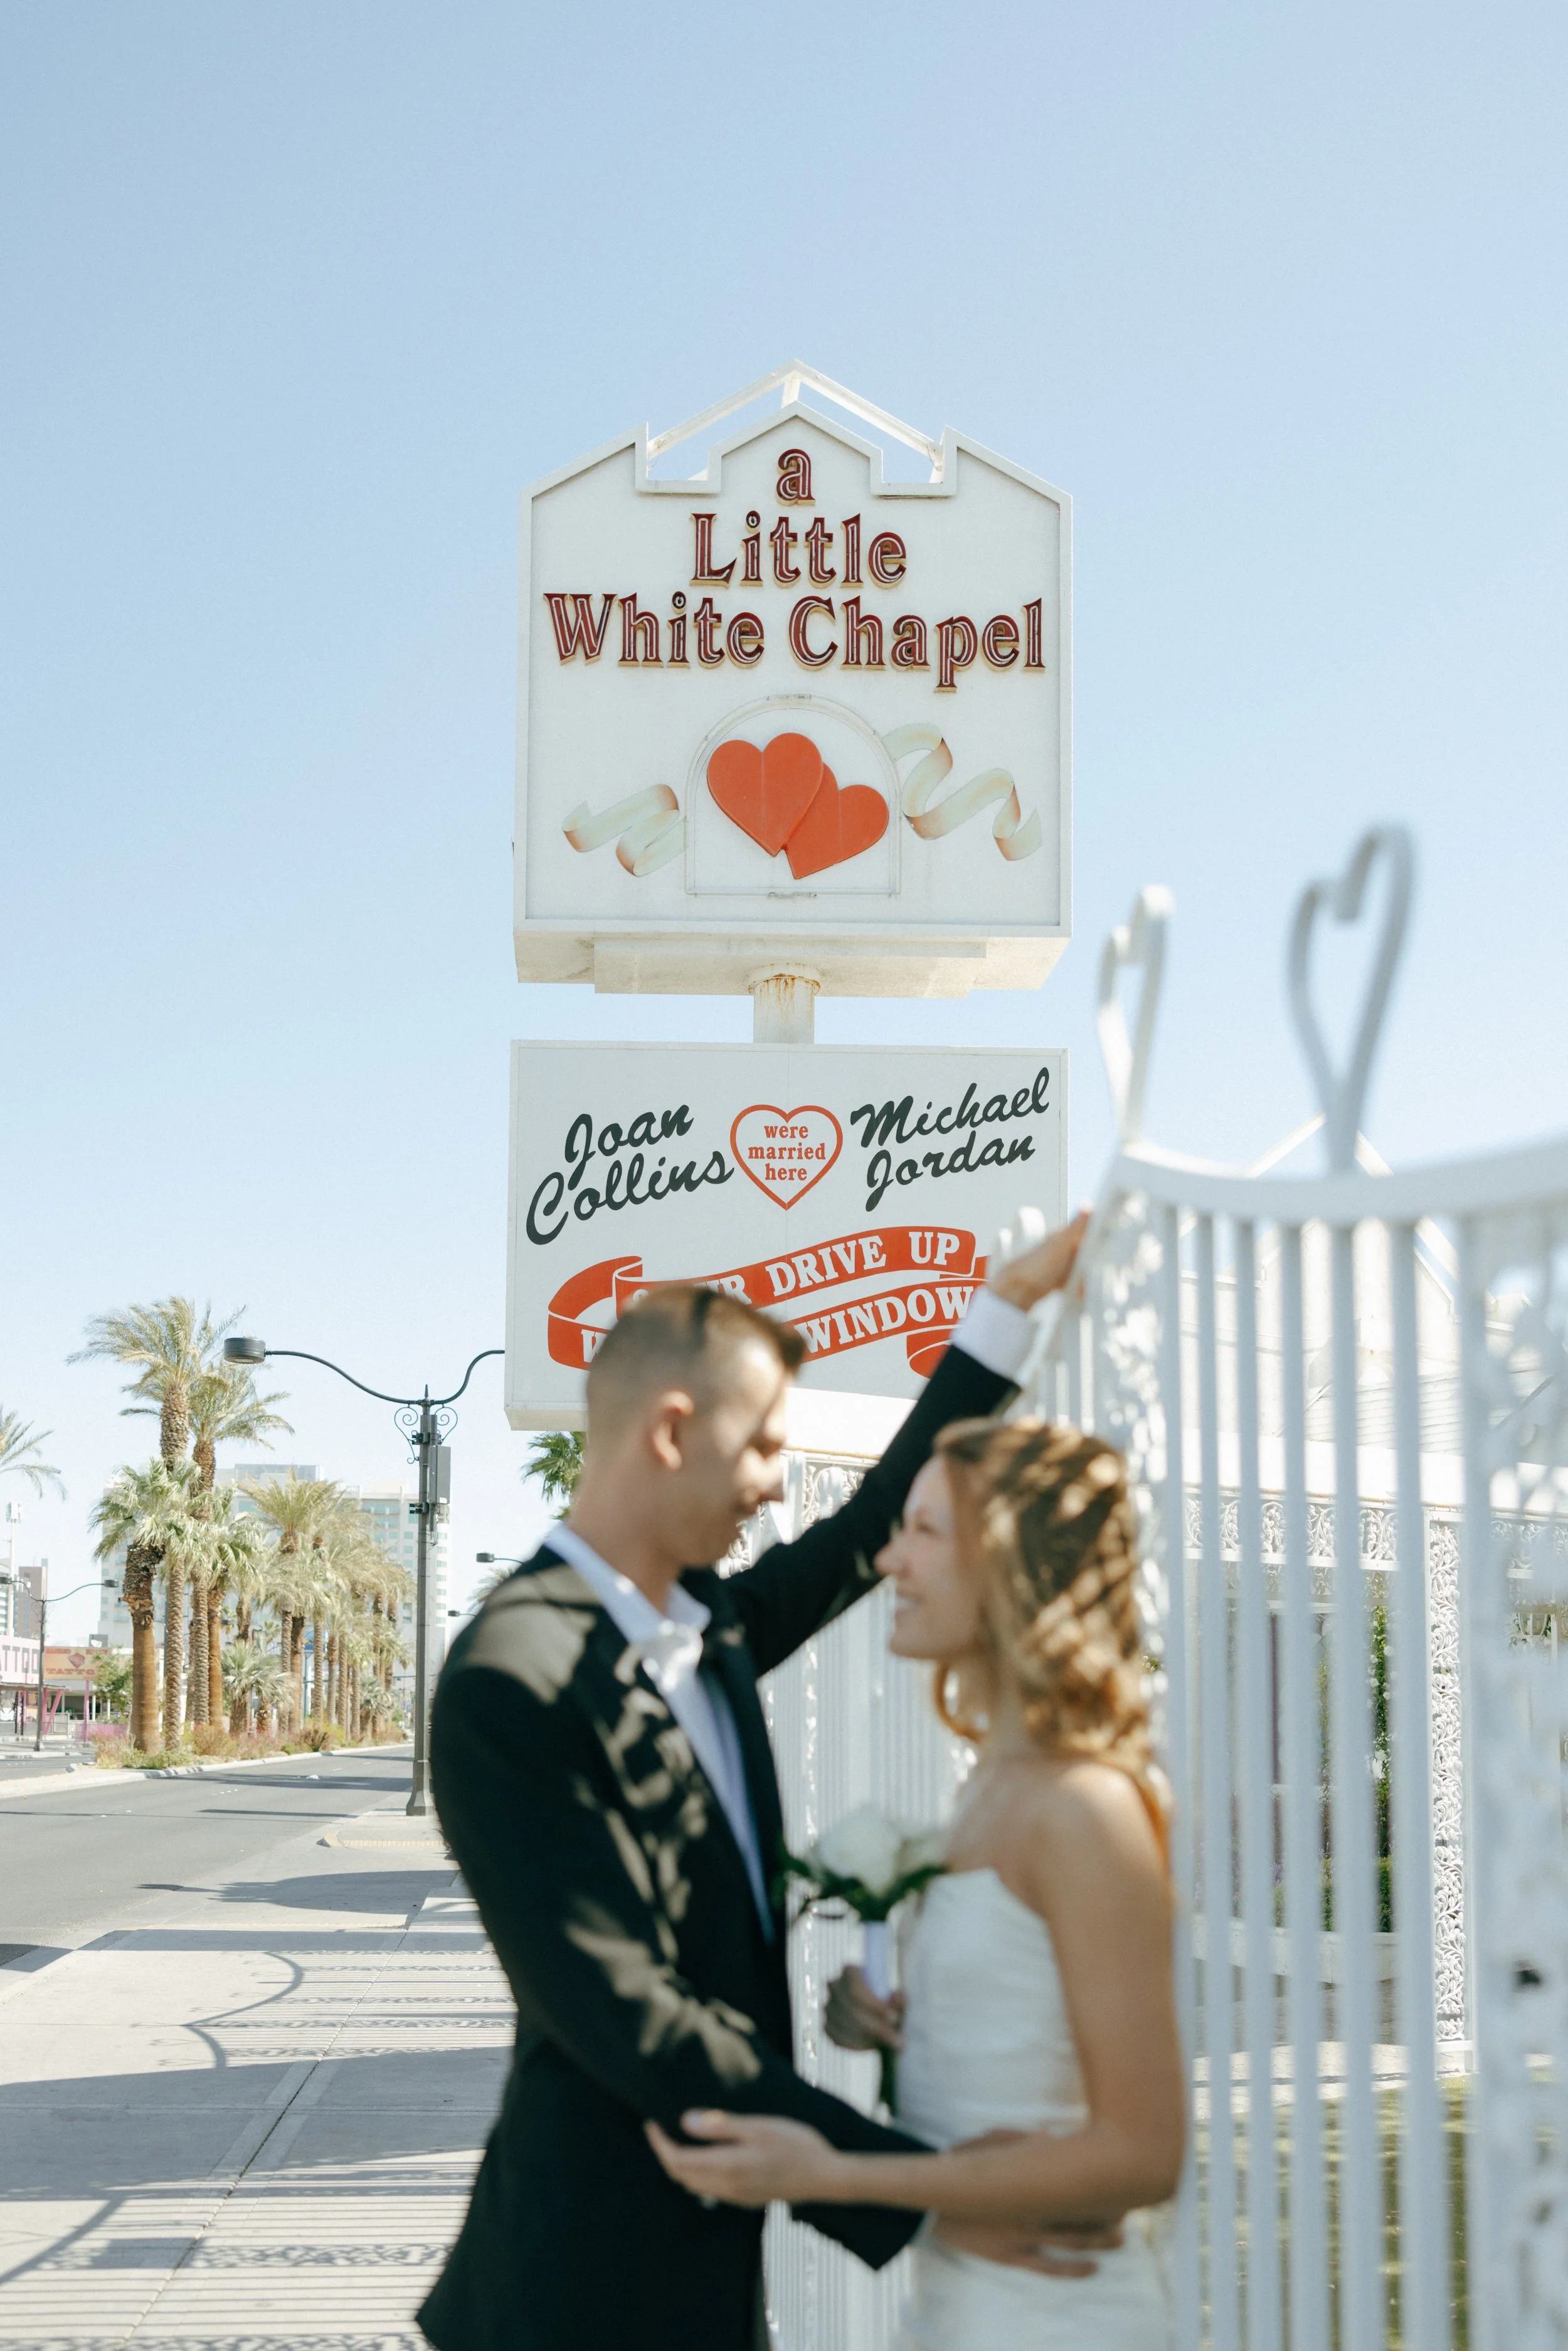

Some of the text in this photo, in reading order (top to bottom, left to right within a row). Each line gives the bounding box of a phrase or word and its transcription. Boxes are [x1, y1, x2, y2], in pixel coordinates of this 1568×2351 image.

[776, 448, 815, 506] a
[689, 510, 907, 589] Little
[543, 591, 1046, 693] White Chapel
[764, 1125, 808, 1139] were
[850, 1067, 1050, 1148] Michael
[564, 1104, 694, 1191] Joan
[748, 1142, 826, 1160] married
[765, 1163, 807, 1181] here
[865, 1130, 1036, 1213] Jordan
[526, 1150, 735, 1246] Collins
[765, 1235, 887, 1297] DRIVE
[908, 1231, 960, 1266] UP
[793, 1286, 974, 1354] WINDOW
[0, 1644, 40, 1674] TTOO
